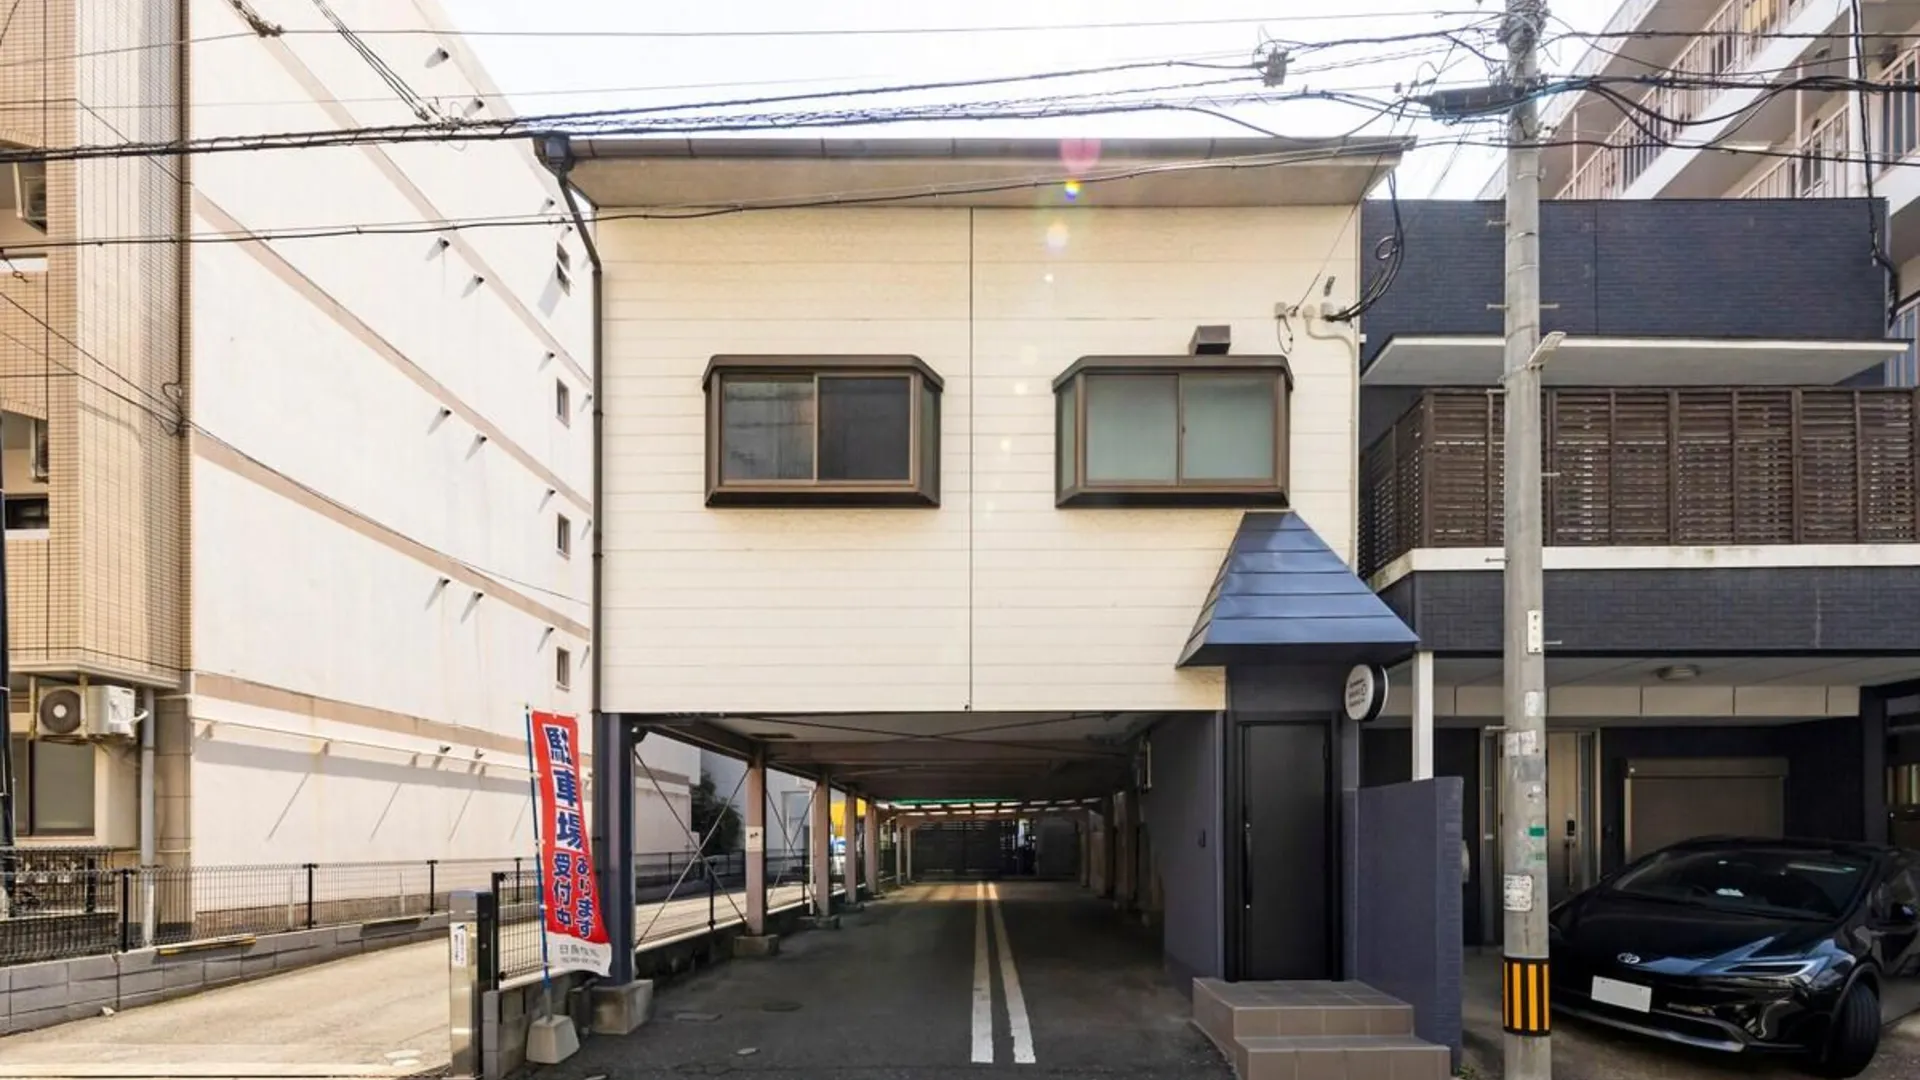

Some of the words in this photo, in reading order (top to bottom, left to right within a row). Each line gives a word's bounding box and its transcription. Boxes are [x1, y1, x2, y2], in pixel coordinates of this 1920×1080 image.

[545, 726, 582, 850] 駐車場
[554, 852, 571, 926] 受付中
[576, 857, 593, 937] あります
